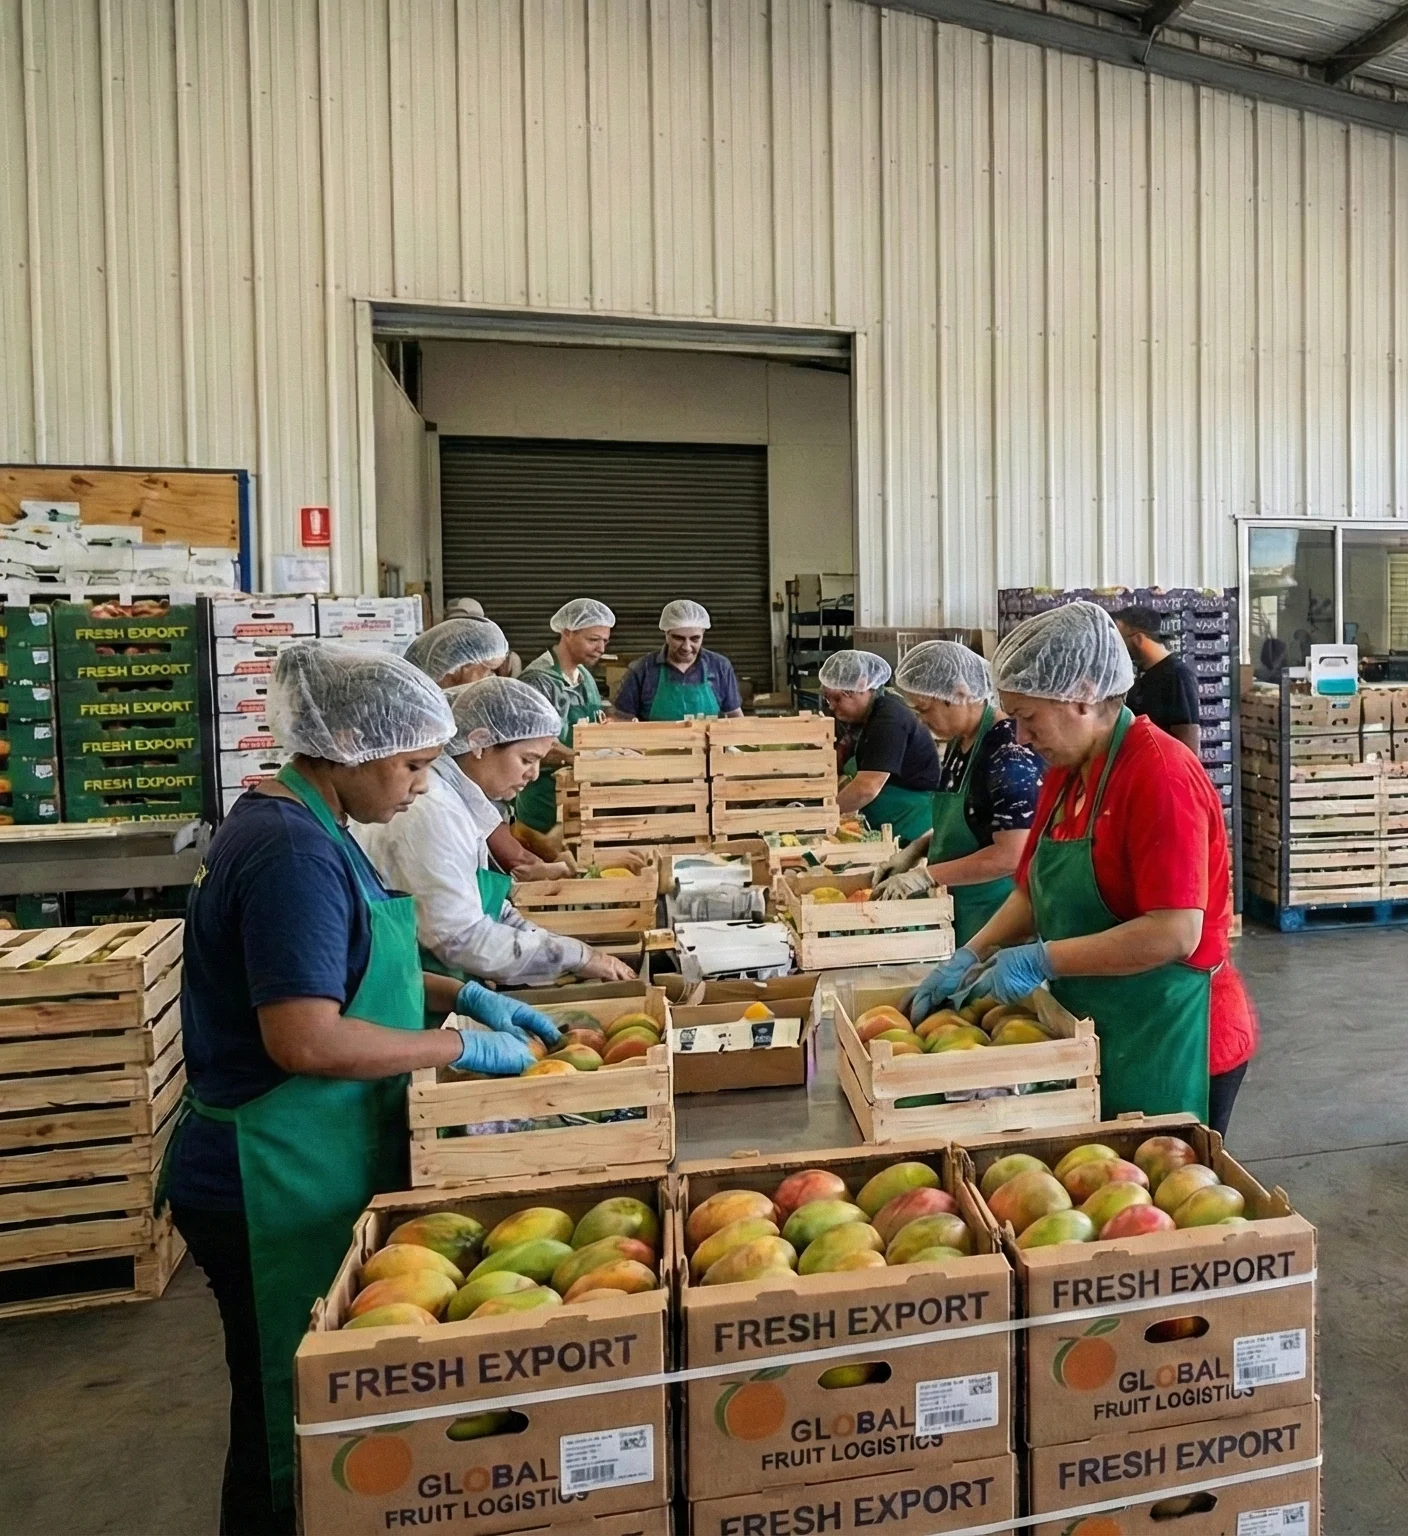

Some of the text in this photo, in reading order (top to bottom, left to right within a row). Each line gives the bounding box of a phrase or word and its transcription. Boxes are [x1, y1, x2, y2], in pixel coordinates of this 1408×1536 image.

[75, 626, 188, 640] FRESH EXPORT
[77, 663, 191, 679] FRESH EXPORT
[80, 701, 194, 716] FRESH EXPORT
[82, 738, 195, 753] FRESH EXPORT
[83, 775, 196, 791] FRESH EXPORT
[1052, 1250, 1296, 1309] FRESH EXPORT
[714, 1291, 990, 1355] FRESH EXPORT
[328, 1333, 638, 1404] FRESH EXPORT
[1118, 1356, 1230, 1394] GLOBAL
[790, 1406, 916, 1443] GLOBAL
[1093, 1396, 1151, 1421] FRUIT
[761, 1447, 826, 1471] FRUIT
[1058, 1423, 1302, 1490] FRESH EXPORT
[417, 1458, 559, 1499] GLOBAL
[384, 1502, 459, 1530] FRUIT
[853, 1477, 995, 1528] EXPORT
